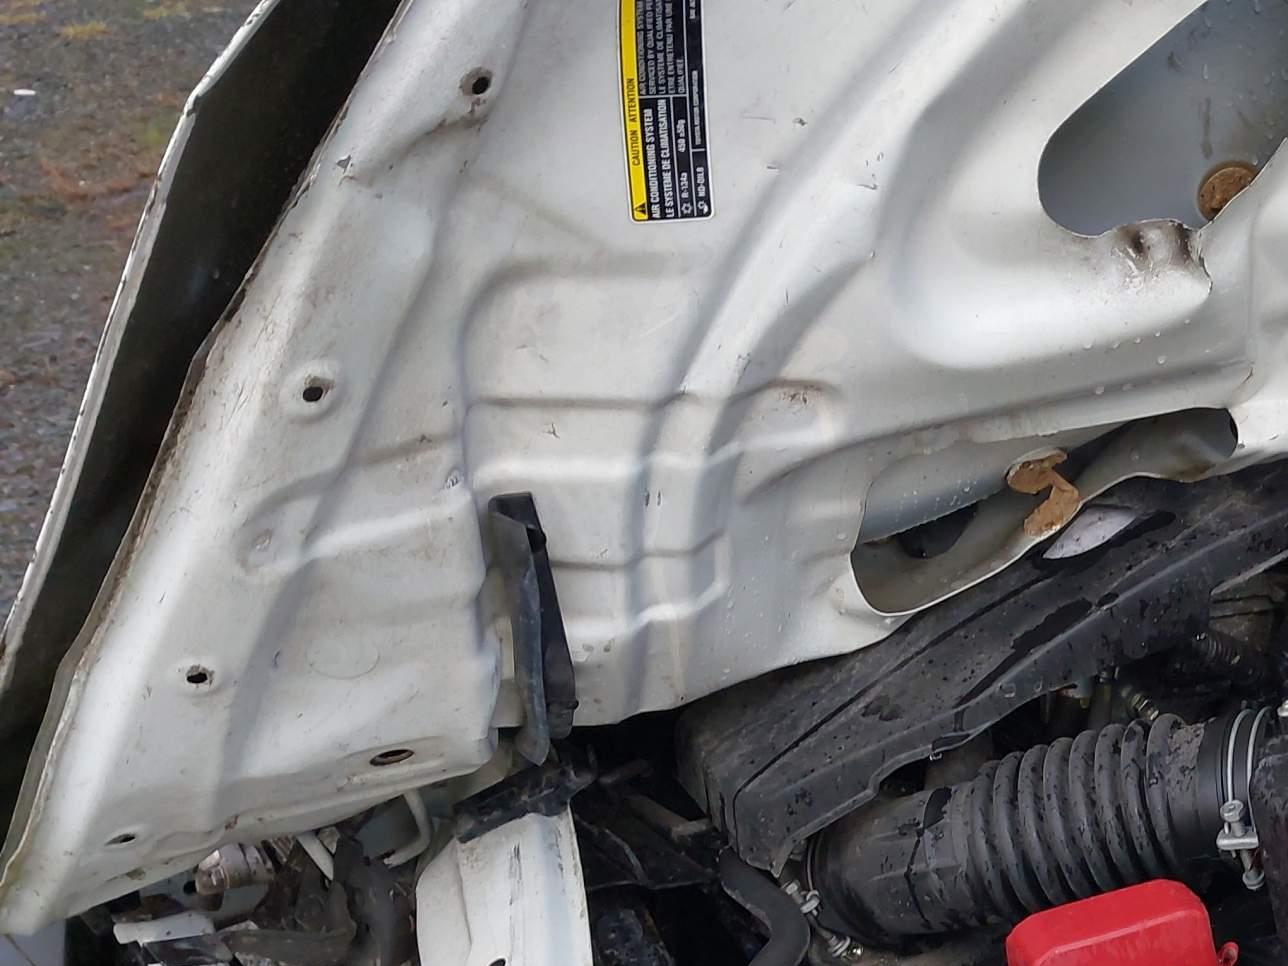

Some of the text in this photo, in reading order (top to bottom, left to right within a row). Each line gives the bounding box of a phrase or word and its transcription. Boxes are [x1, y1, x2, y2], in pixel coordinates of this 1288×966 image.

[647, 49, 654, 58] BY
[626, 78, 640, 166] CAUTION ATTENTION
[644, 108, 655, 142] SYSTEM
[646, 144, 660, 202] CONDITIONING
[658, 99, 674, 217] LE SYSTEME DE CLIMATISATION
[680, 172, 688, 198] R-134a
